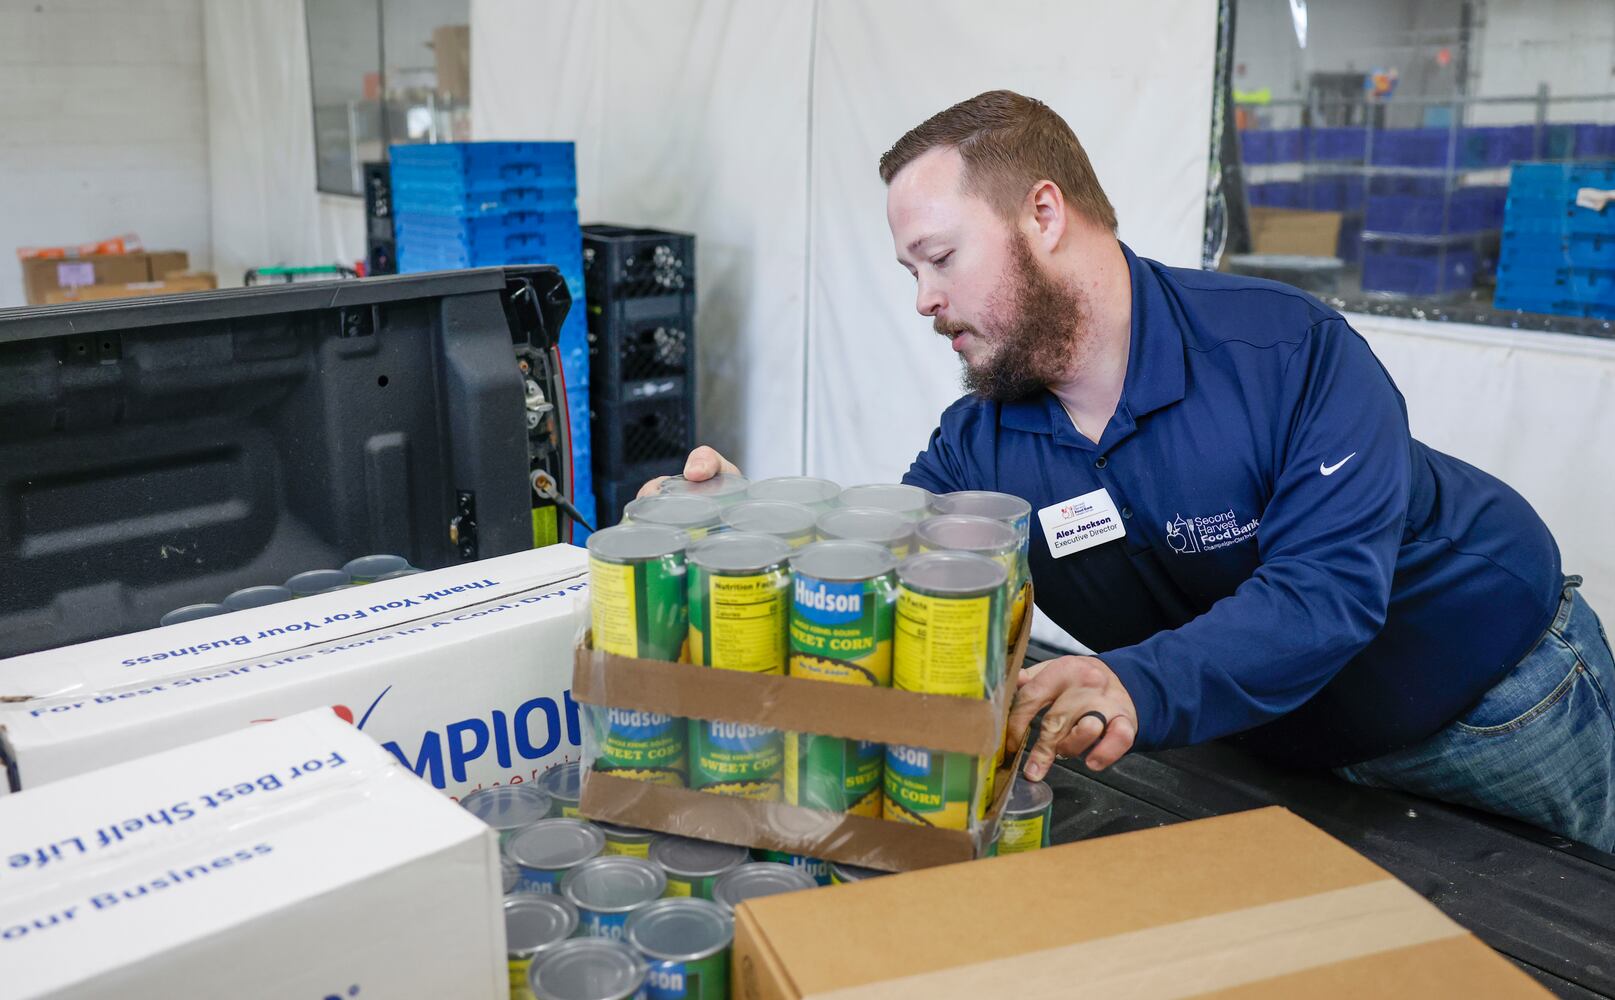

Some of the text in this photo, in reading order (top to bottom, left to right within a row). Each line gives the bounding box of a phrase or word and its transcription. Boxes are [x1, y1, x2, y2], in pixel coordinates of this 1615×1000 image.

[1056, 516, 1112, 540] Alex Jackson
[1194, 509, 1236, 527] Second
[1198, 519, 1238, 536] Harvest
[1054, 523, 1118, 549] Executive Director
[1201, 519, 1260, 545] Food Bank
[714, 581, 754, 591] Nutrition
[795, 578, 861, 613] Hudson
[121, 578, 500, 667] Thank You For Your Business
[30, 701, 84, 718] For
[93, 685, 168, 704] Best
[172, 667, 251, 687] Shelf
[257, 654, 313, 669] Life
[317, 635, 394, 654] Store
[397, 627, 425, 636] In
[519, 589, 566, 606] Dry
[829, 636, 873, 650] CORN
[380, 689, 582, 790] MPIO
[900, 787, 942, 807] CORN
[7, 752, 347, 869] For Best Shelf Life
[1, 842, 274, 940] our Business
